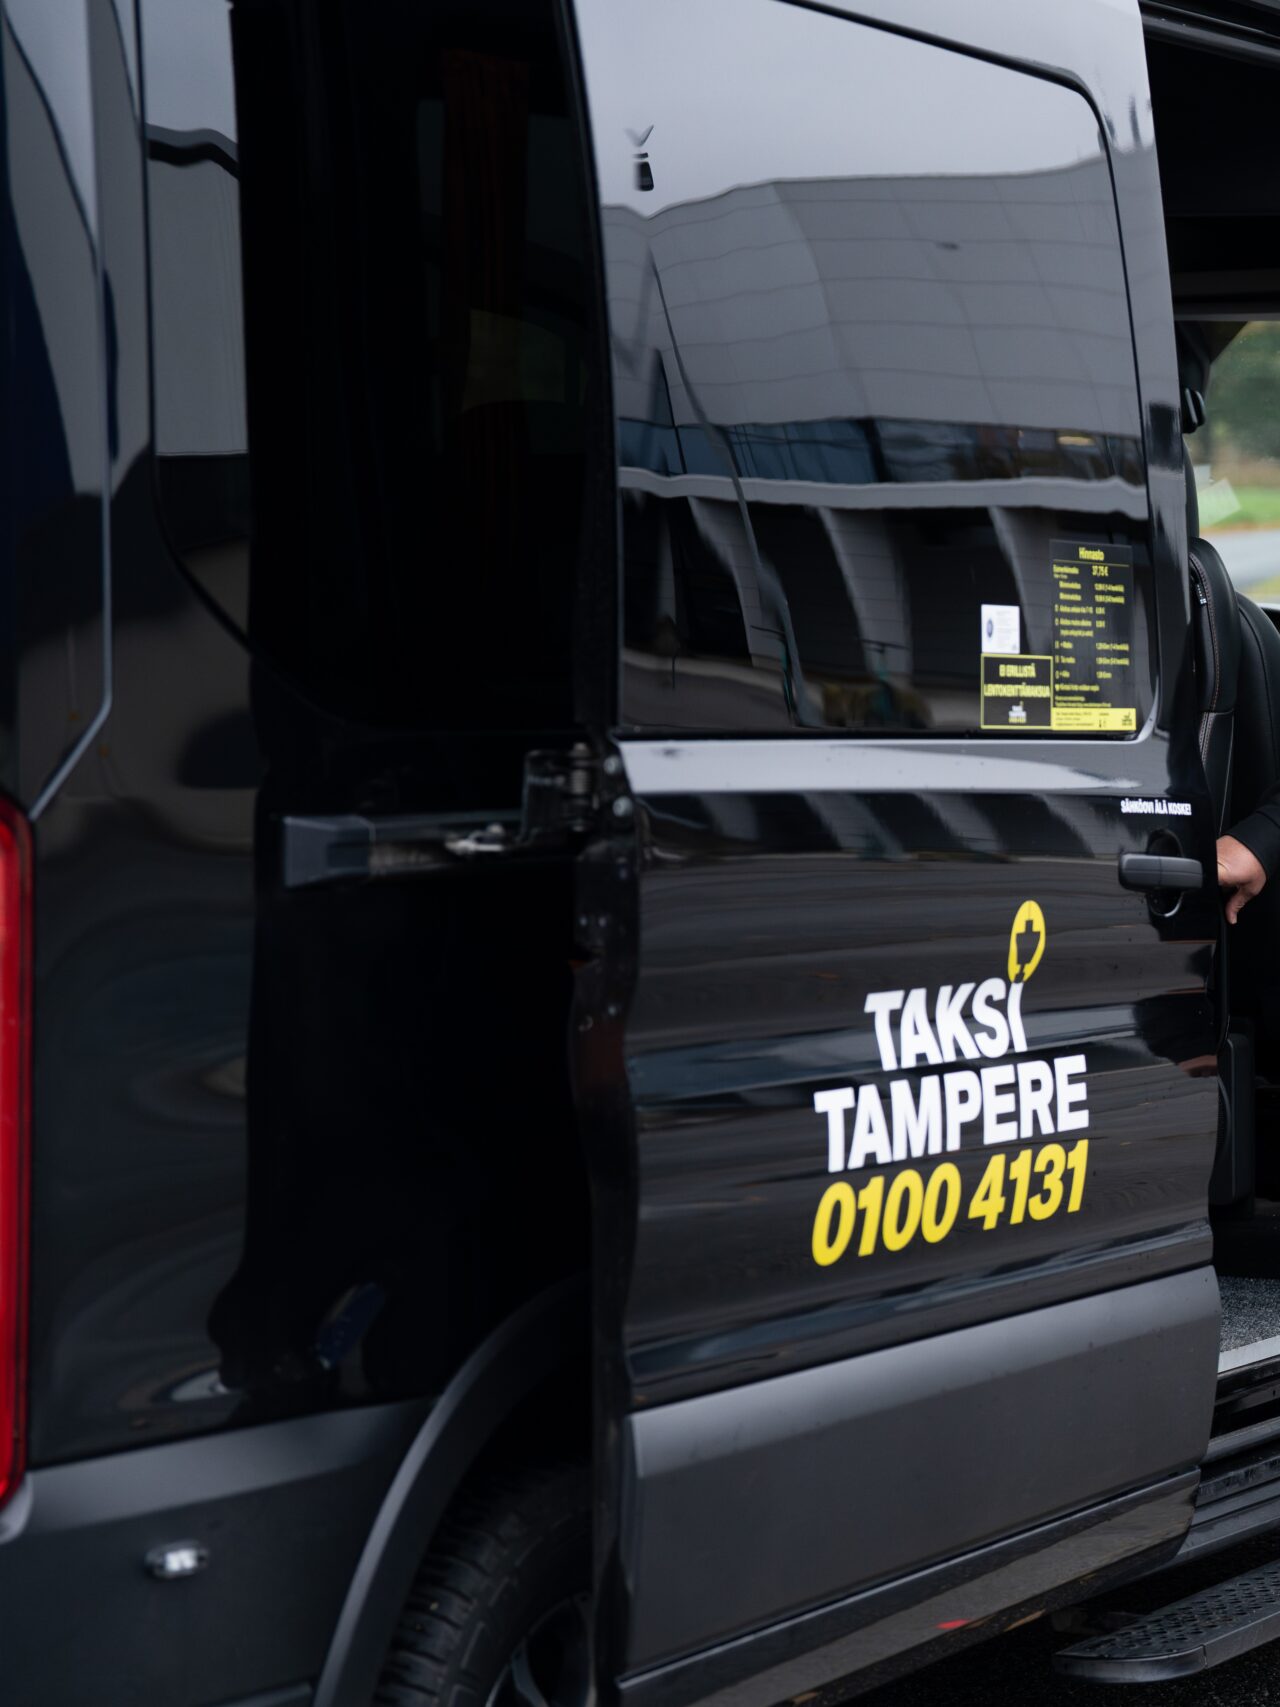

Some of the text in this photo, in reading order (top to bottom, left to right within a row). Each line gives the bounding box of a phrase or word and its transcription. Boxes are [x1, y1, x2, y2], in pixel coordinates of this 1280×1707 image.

[863, 965, 1030, 1072] TAKSI
[813, 1054, 1089, 1173] TAMPERE
[811, 1138, 1089, 1267] 0100 4131
